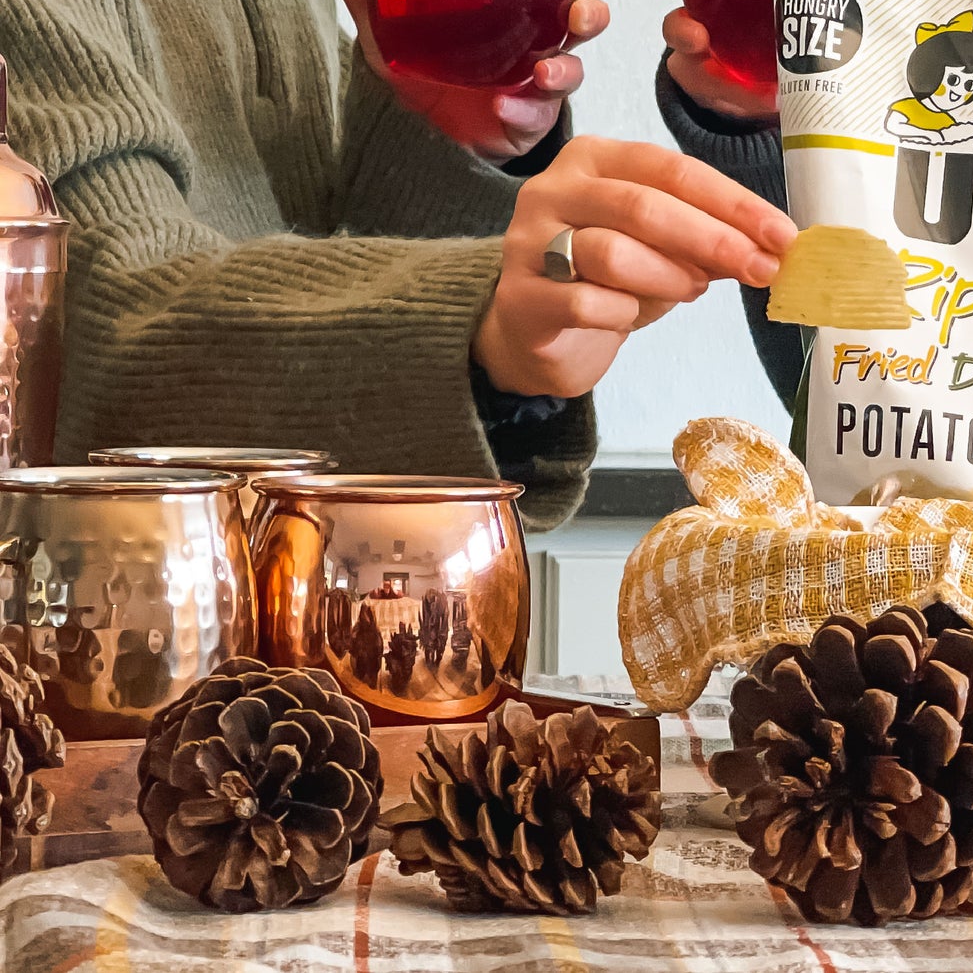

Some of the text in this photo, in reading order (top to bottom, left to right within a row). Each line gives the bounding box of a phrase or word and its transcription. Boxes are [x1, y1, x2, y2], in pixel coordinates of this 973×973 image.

[782, 16, 844, 61] SIZE
[814, 79, 844, 95] FREE
[832, 343, 939, 385] Fried
